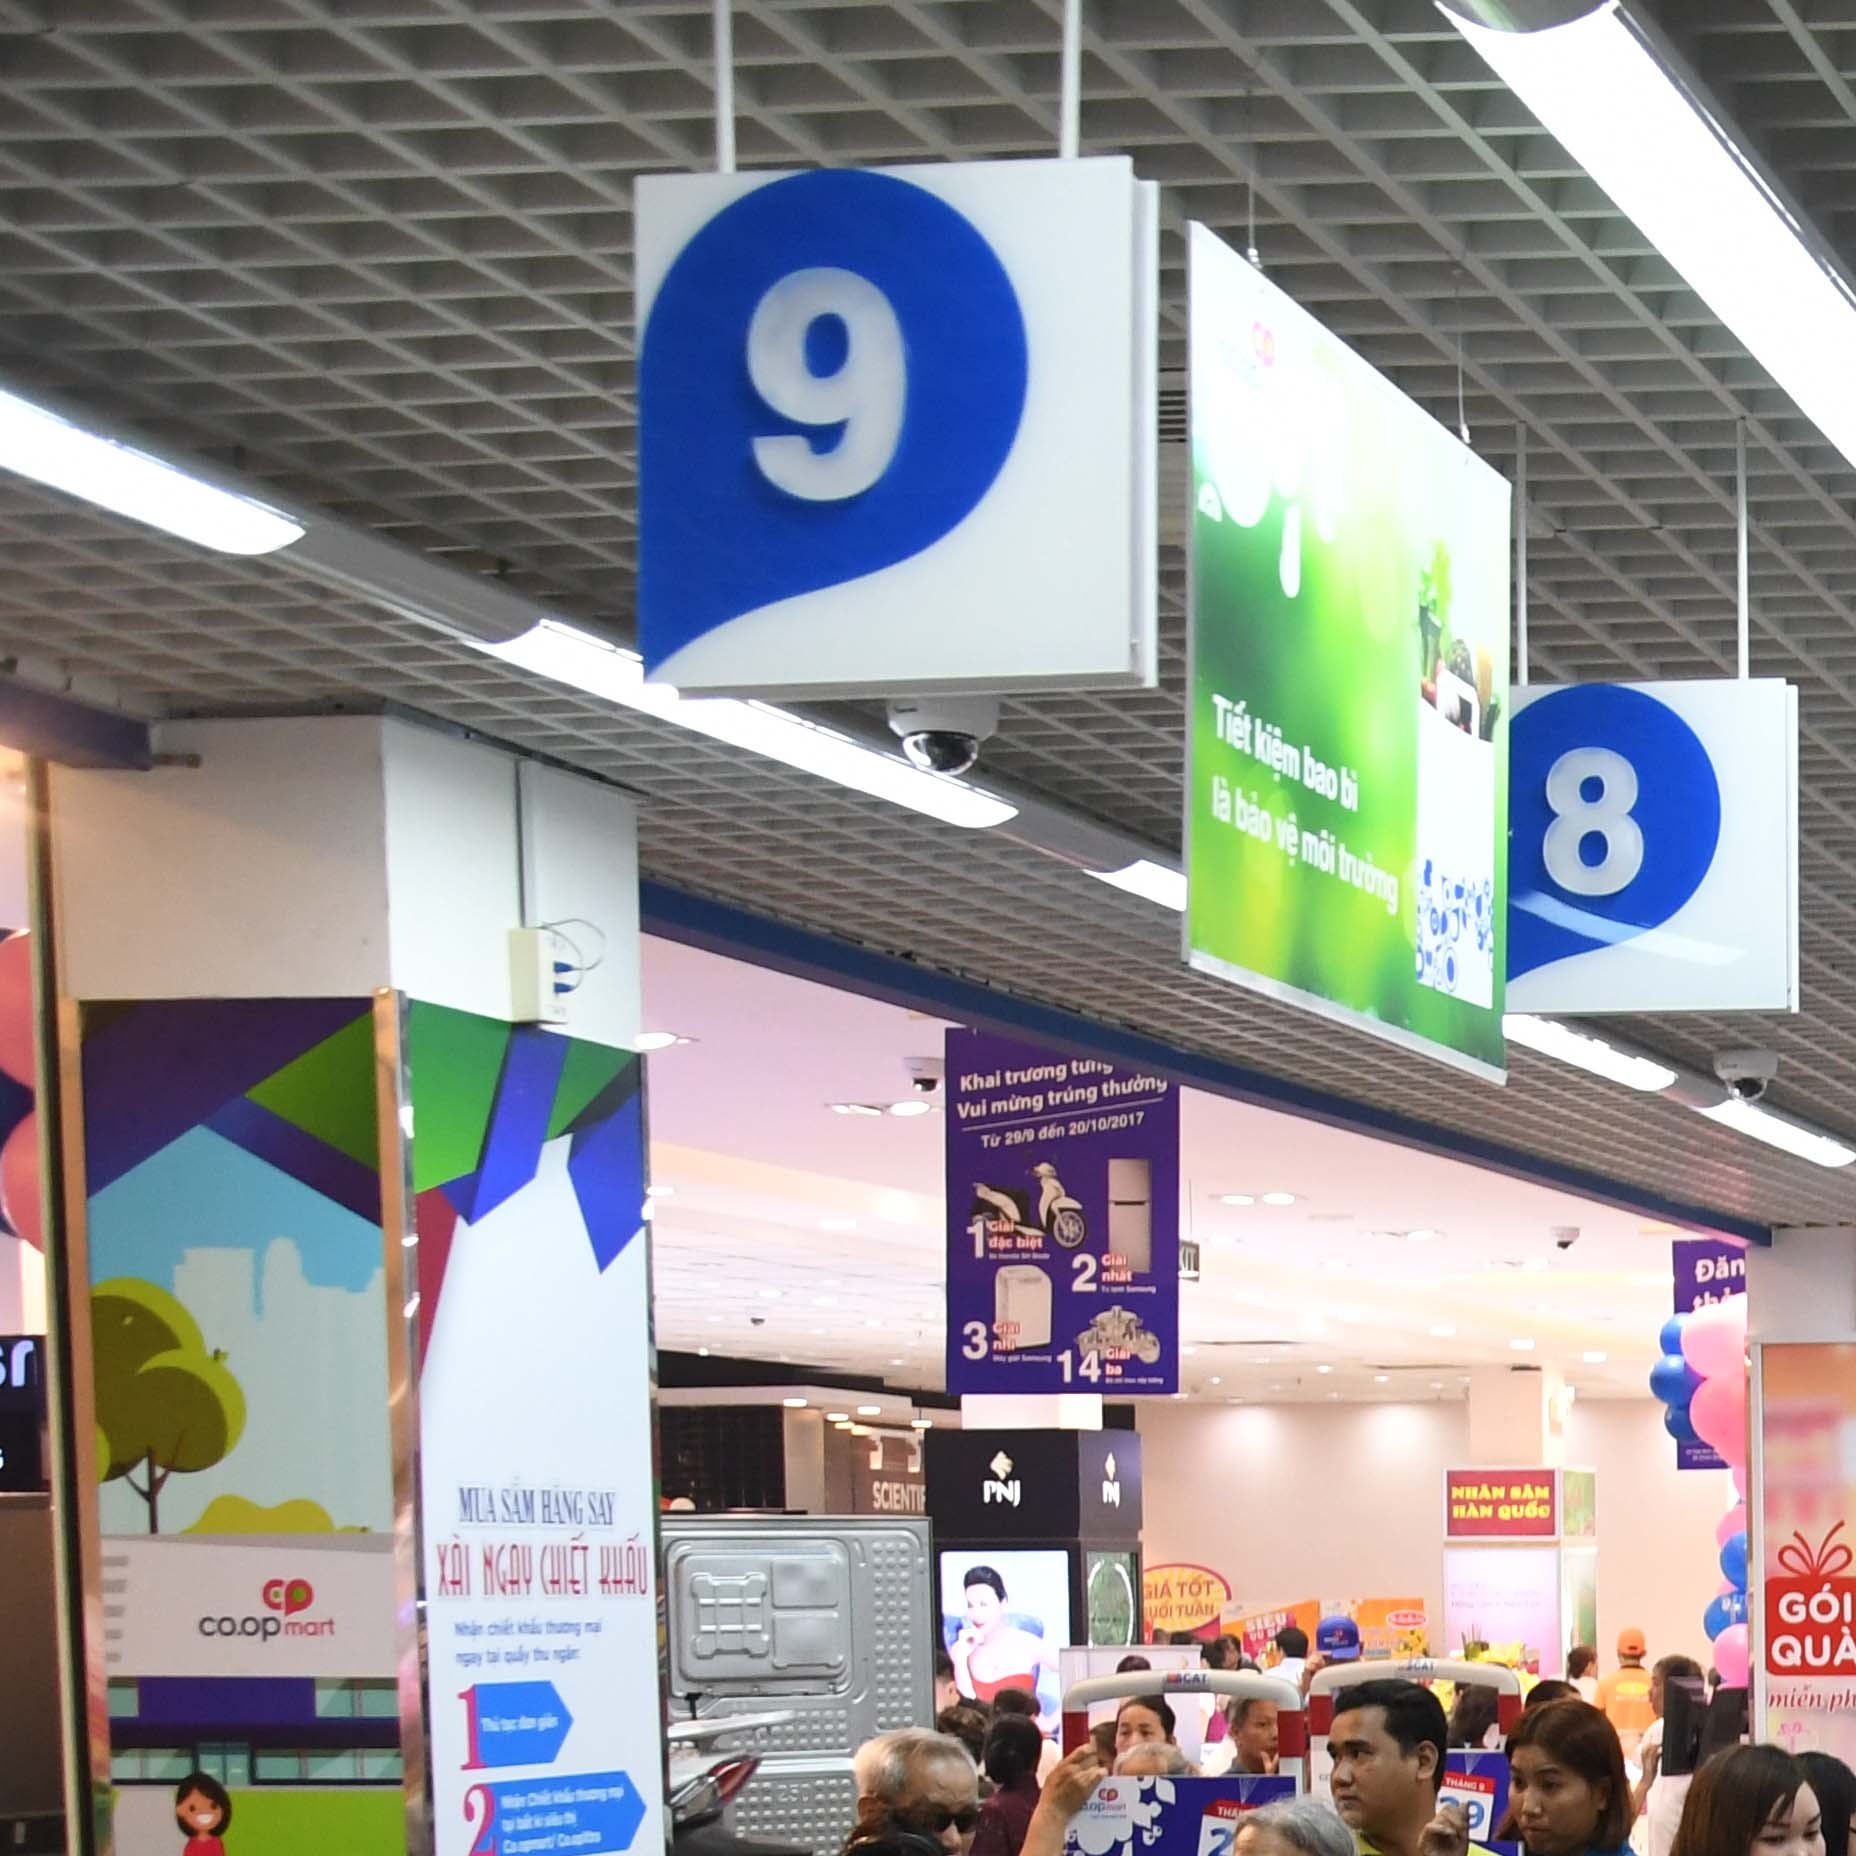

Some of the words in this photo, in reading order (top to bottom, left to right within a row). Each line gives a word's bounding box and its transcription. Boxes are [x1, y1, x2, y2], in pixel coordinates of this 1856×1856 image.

[746, 266, 909, 503] 9
[1212, 693, 1252, 754] Tiết
[1255, 718, 1300, 781] kiệm
[1303, 745, 1338, 800] bao
[1341, 766, 1358, 811] bì
[1212, 775, 1231, 823] là
[1275, 812, 1298, 867] vệ
[1302, 829, 1336, 875] môi
[1542, 745, 1646, 897] 8
[960, 1072, 1001, 1092] Khai
[1005, 1062, 1066, 1087] trương
[957, 1101, 987, 1119] Vui
[991, 1092, 1043, 1114] mừng
[1047, 1083, 1098, 1106] trúng
[1068, 1111, 1145, 1137] 20/10/2017
[967, 1221, 984, 1259] 1
[1071, 1253, 1098, 1293] 2
[962, 1321, 989, 1360] 3
[1057, 1349, 1102, 1383] 14
[458, 1487, 497, 1523] MUA
[587, 1491, 616, 1526] SAY
[983, 1479, 1021, 1507] PNJ
[436, 1532, 471, 1597] XÀI
[482, 1543, 533, 1597] NGAY
[540, 1531, 590, 1596] CHIẾT
[598, 1532, 648, 1597] KHẤU
[1778, 1583, 1853, 1624] GÓI
[199, 1615, 281, 1641] co.op
[284, 1619, 335, 1636] mart
[458, 1684, 488, 1771] 1
